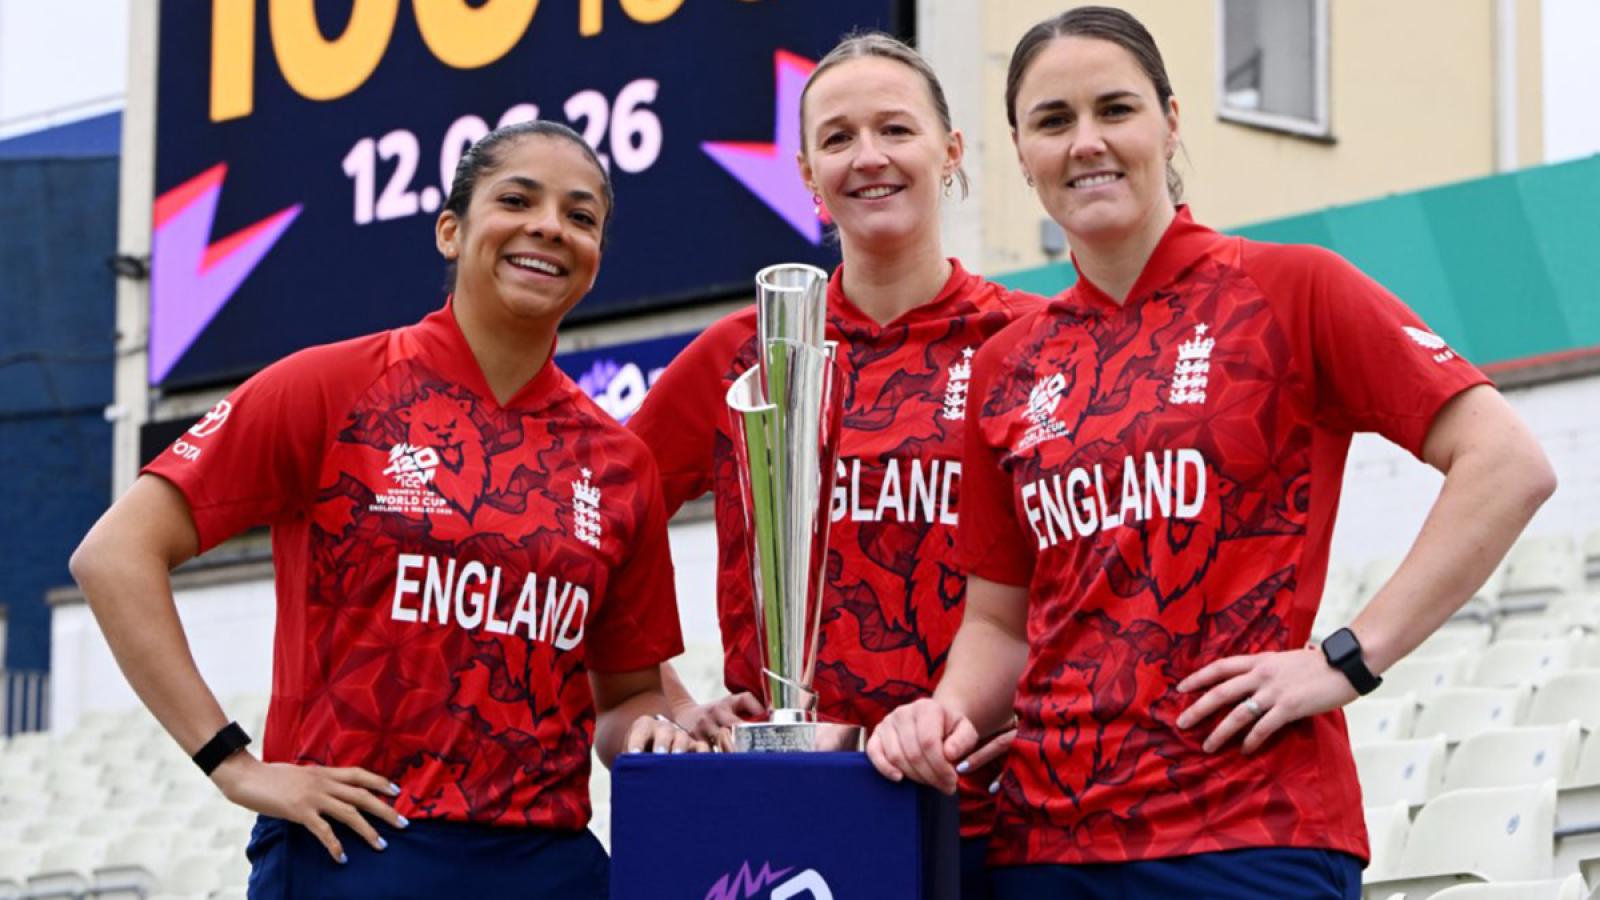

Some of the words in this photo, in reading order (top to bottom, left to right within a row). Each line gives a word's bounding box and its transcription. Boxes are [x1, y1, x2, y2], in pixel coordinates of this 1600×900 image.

[341, 78, 664, 225] 12.026
[375, 493, 420, 505] WORLD
[422, 496, 447, 507] CUP
[830, 458, 962, 525] GLAND
[1021, 448, 1207, 551] ENGLAND
[391, 553, 590, 651] ENGLAND
